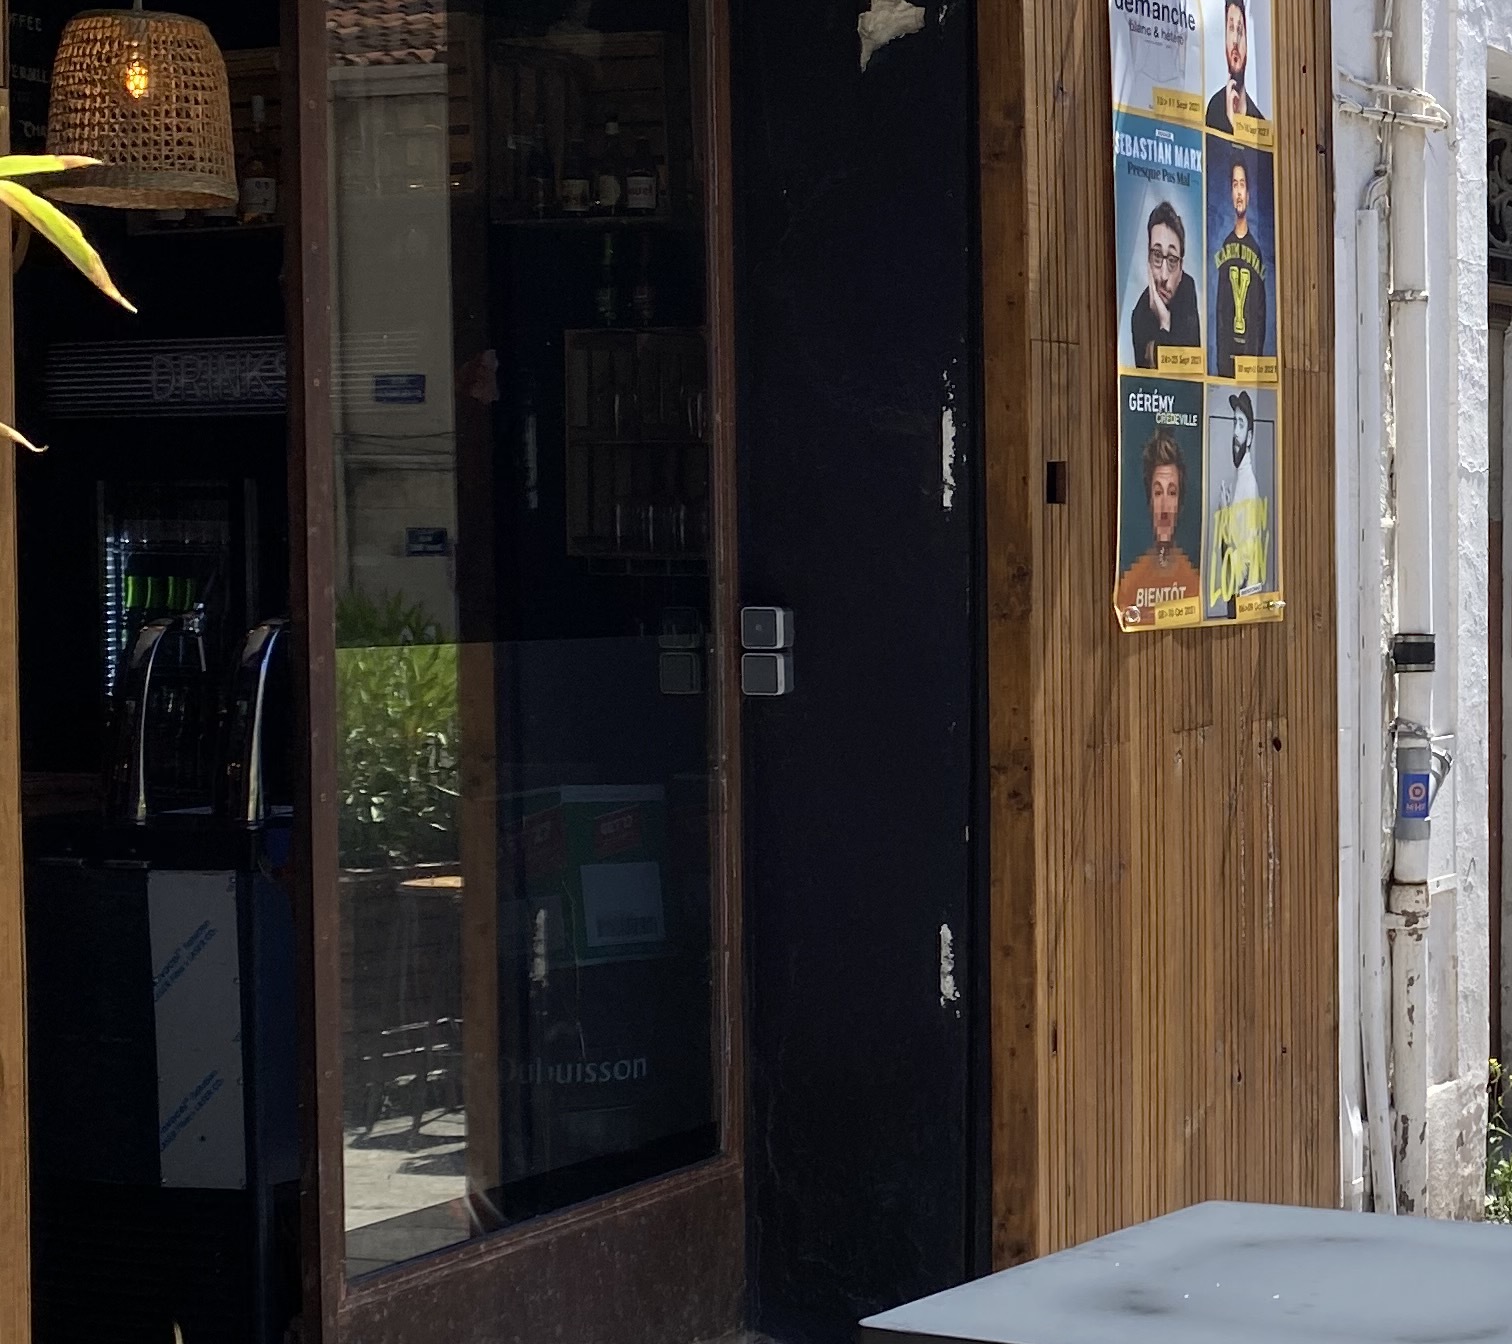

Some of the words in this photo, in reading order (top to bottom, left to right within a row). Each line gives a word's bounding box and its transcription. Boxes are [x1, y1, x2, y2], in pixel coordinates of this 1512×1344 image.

[1174, 144, 1202, 173] MARX
[1127, 160, 1161, 182] Presque
[1162, 168, 1176, 184] Pas
[1176, 172, 1191, 187] Mal
[1128, 387, 1175, 413] GÉRÉMY
[1135, 581, 1187, 608] BIENTÔT
